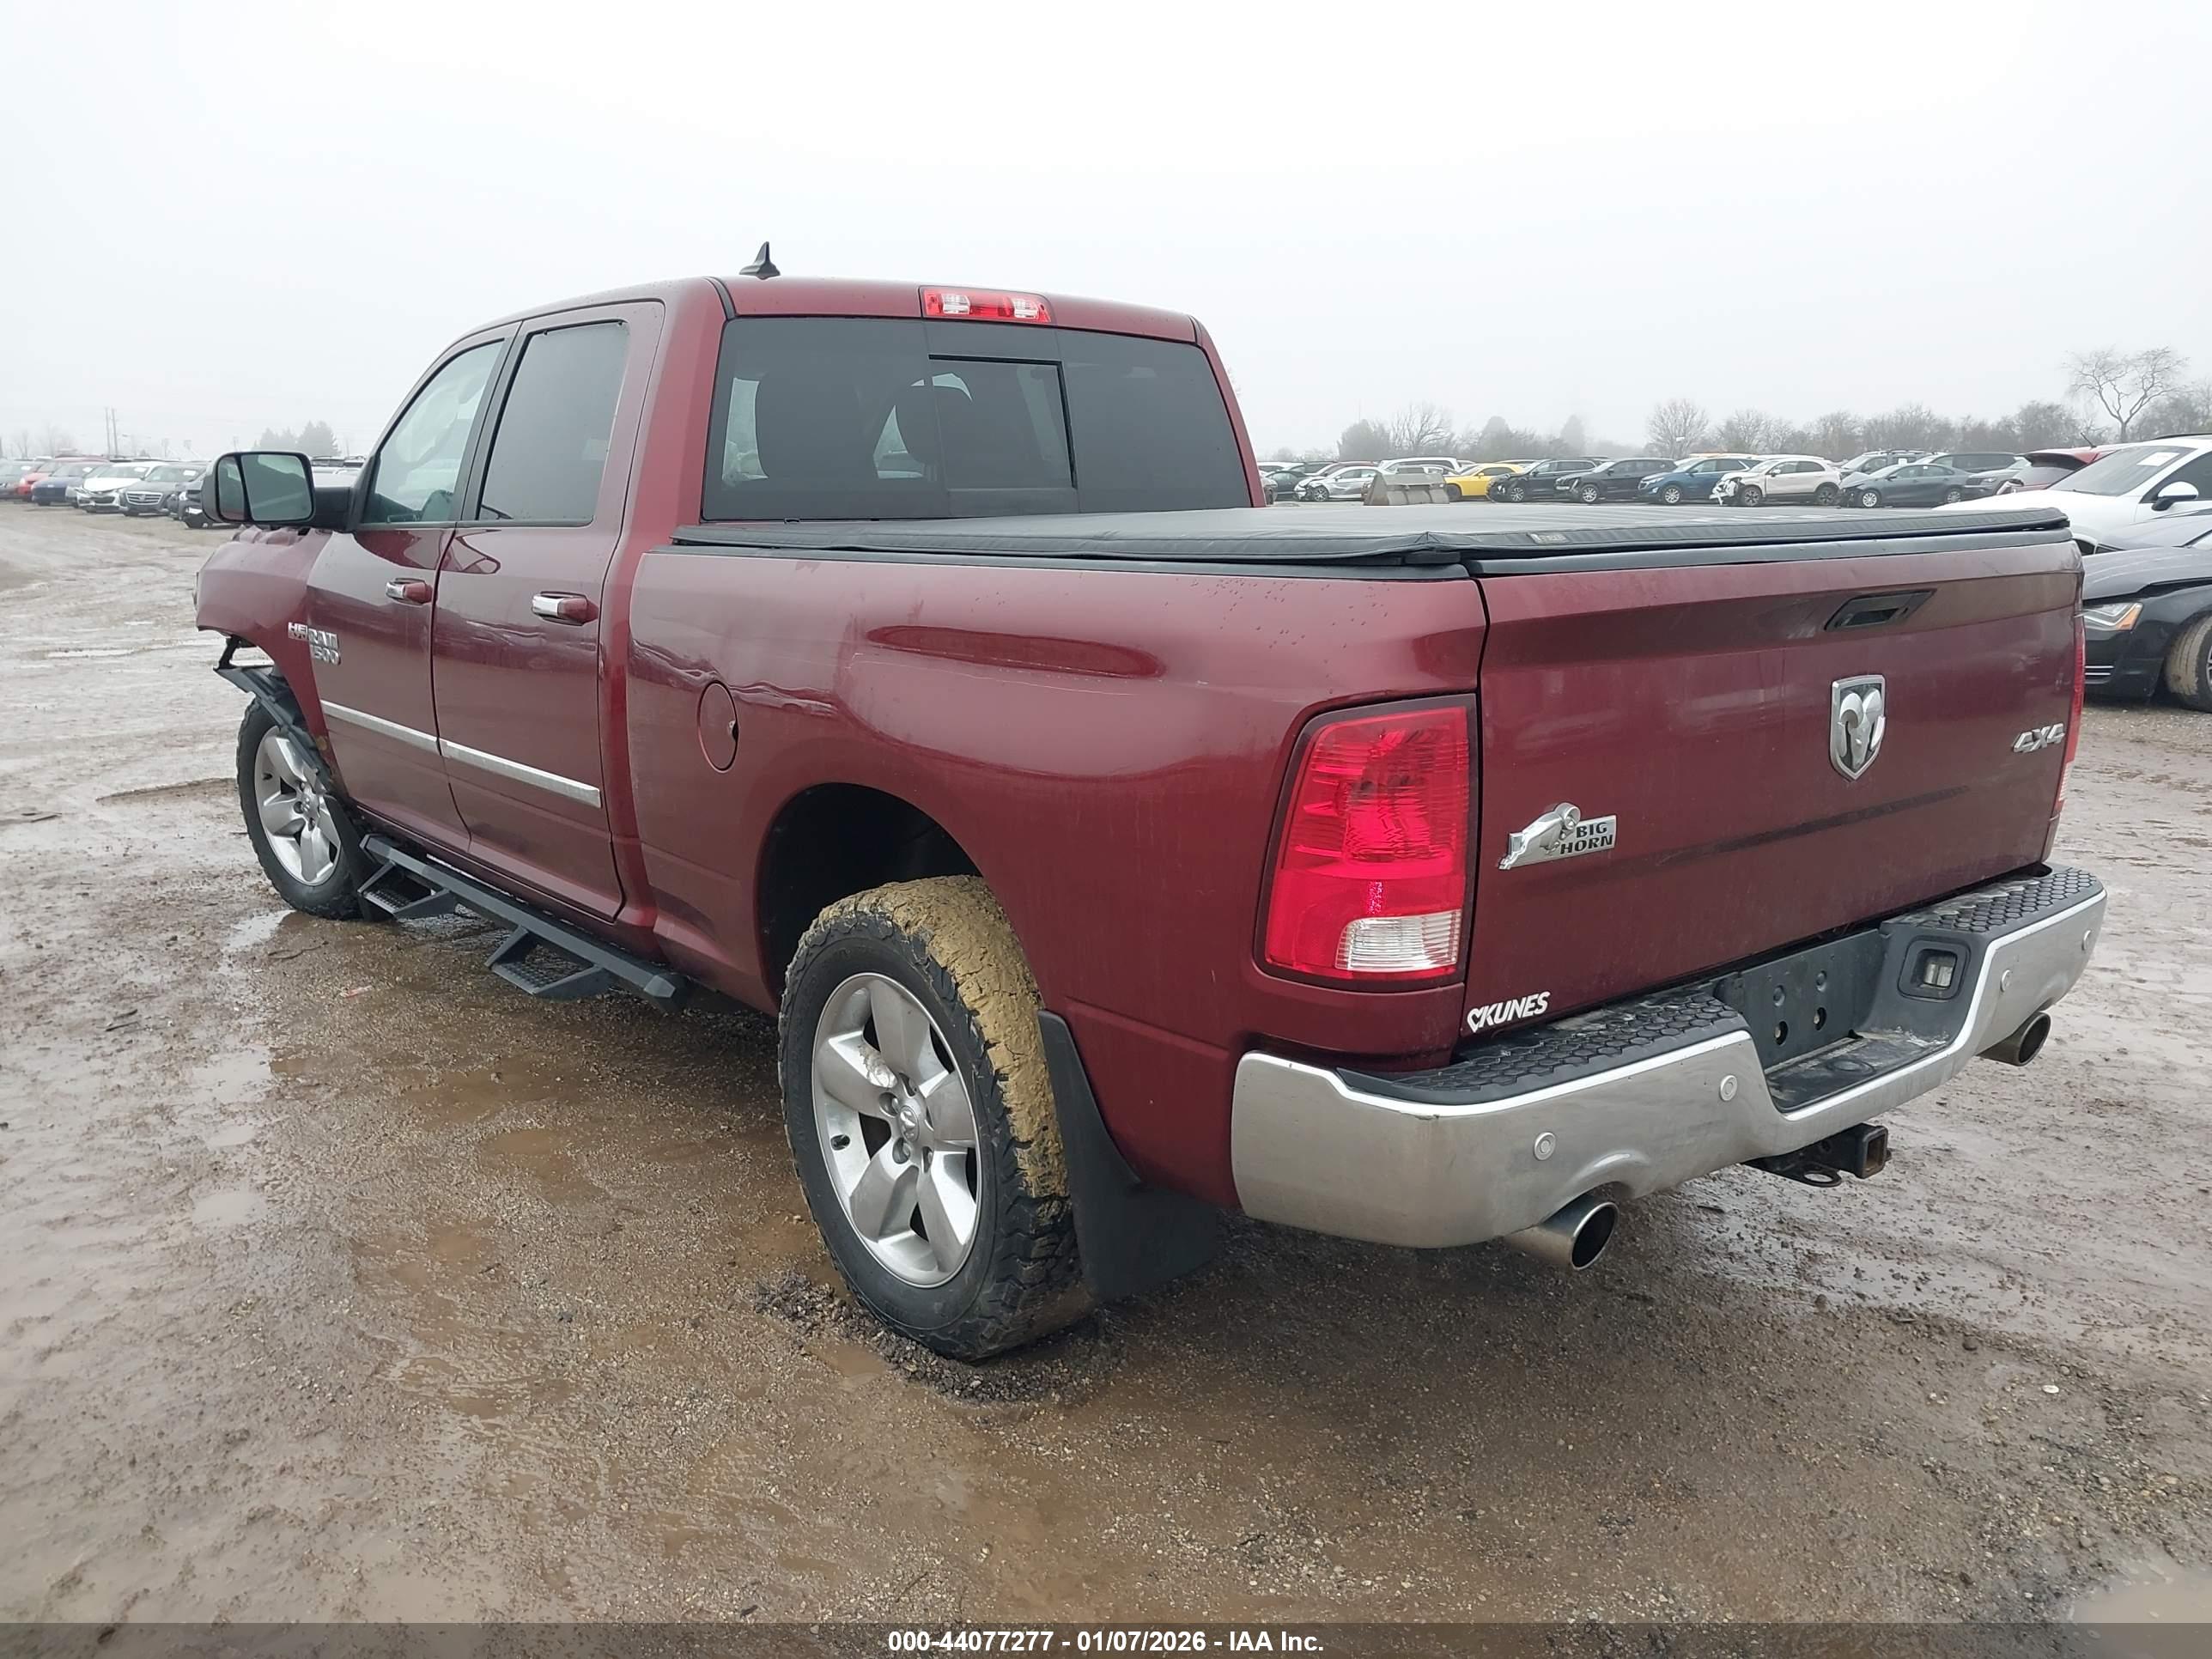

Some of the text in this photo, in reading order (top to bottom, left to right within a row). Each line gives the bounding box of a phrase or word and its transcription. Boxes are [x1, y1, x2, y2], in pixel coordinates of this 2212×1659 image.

[1576, 822, 1607, 838] BIG
[1559, 835, 1613, 854] HORN
[1478, 991, 1551, 1029] KUNES
